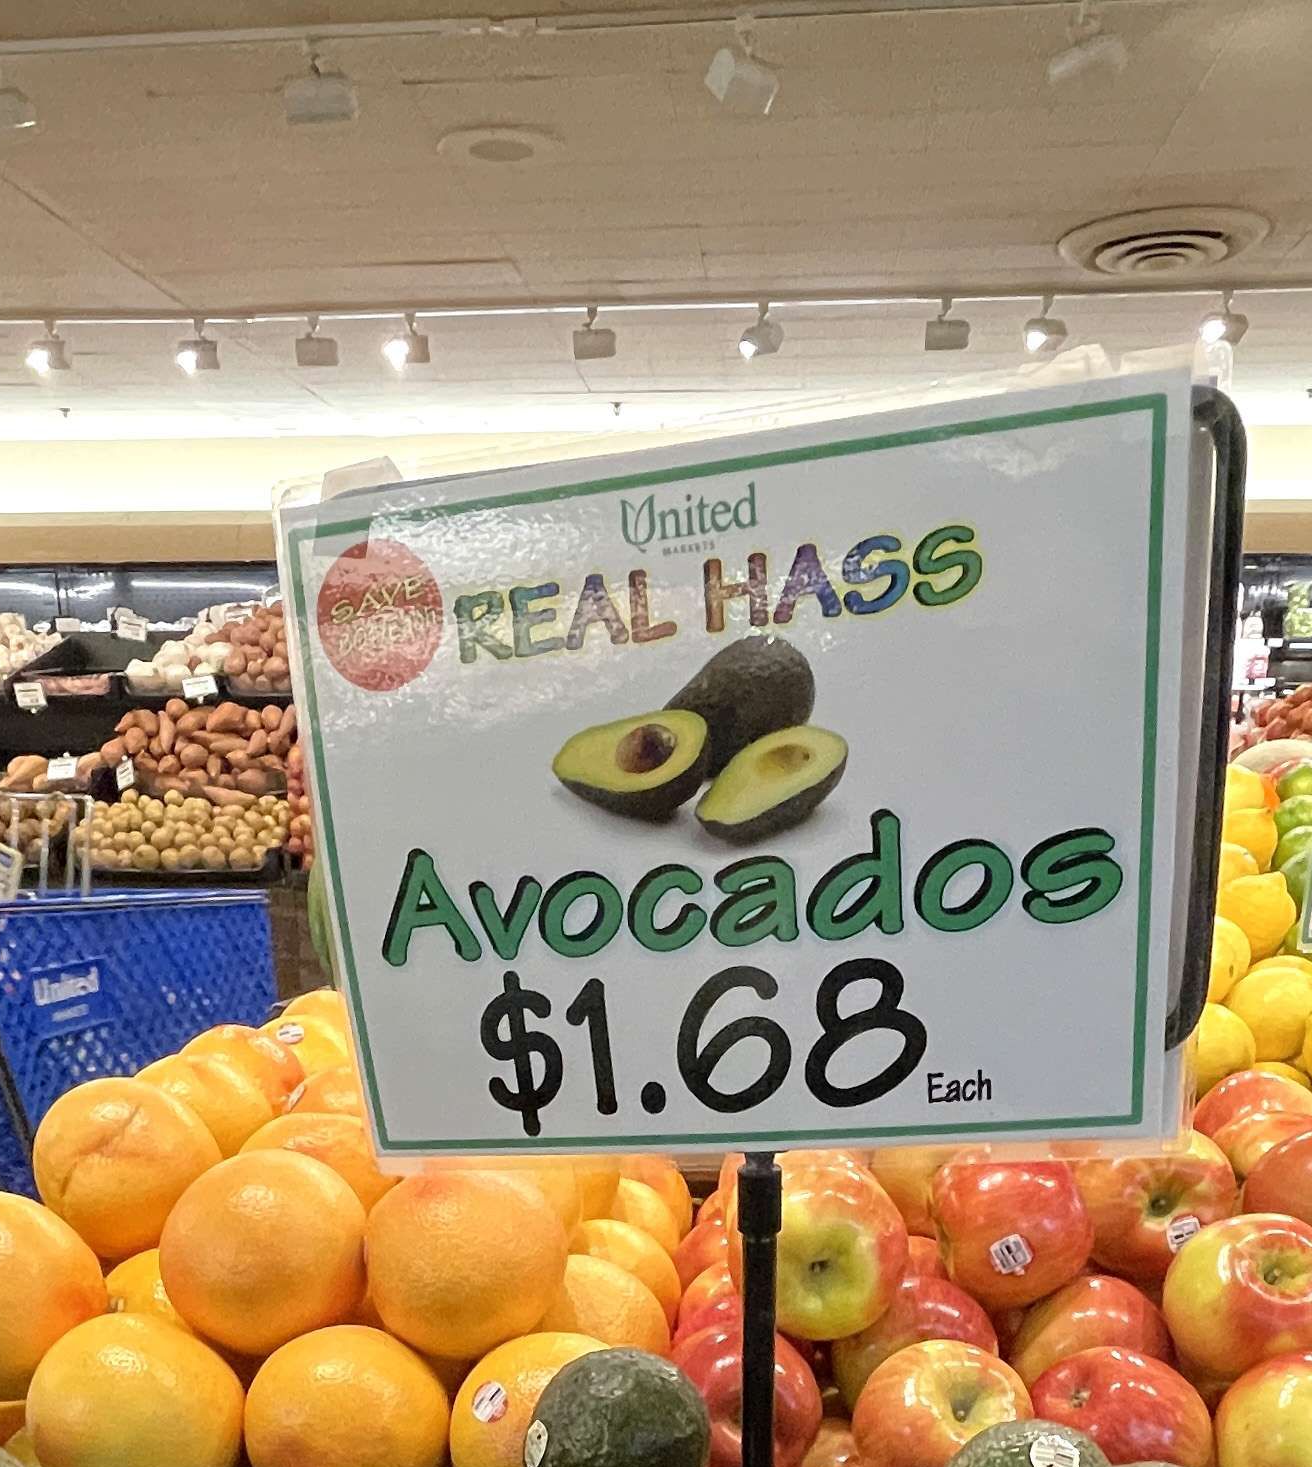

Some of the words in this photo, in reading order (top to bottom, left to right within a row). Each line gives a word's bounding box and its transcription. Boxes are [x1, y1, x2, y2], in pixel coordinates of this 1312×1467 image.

[619, 481, 759, 553] United
[330, 574, 426, 625] SAVE
[452, 568, 678, 665] REAL
[703, 523, 984, 634] HASS
[382, 808, 1123, 967] Avocados
[479, 957, 928, 1136] $1.68
[927, 1070, 992, 1104] Each
